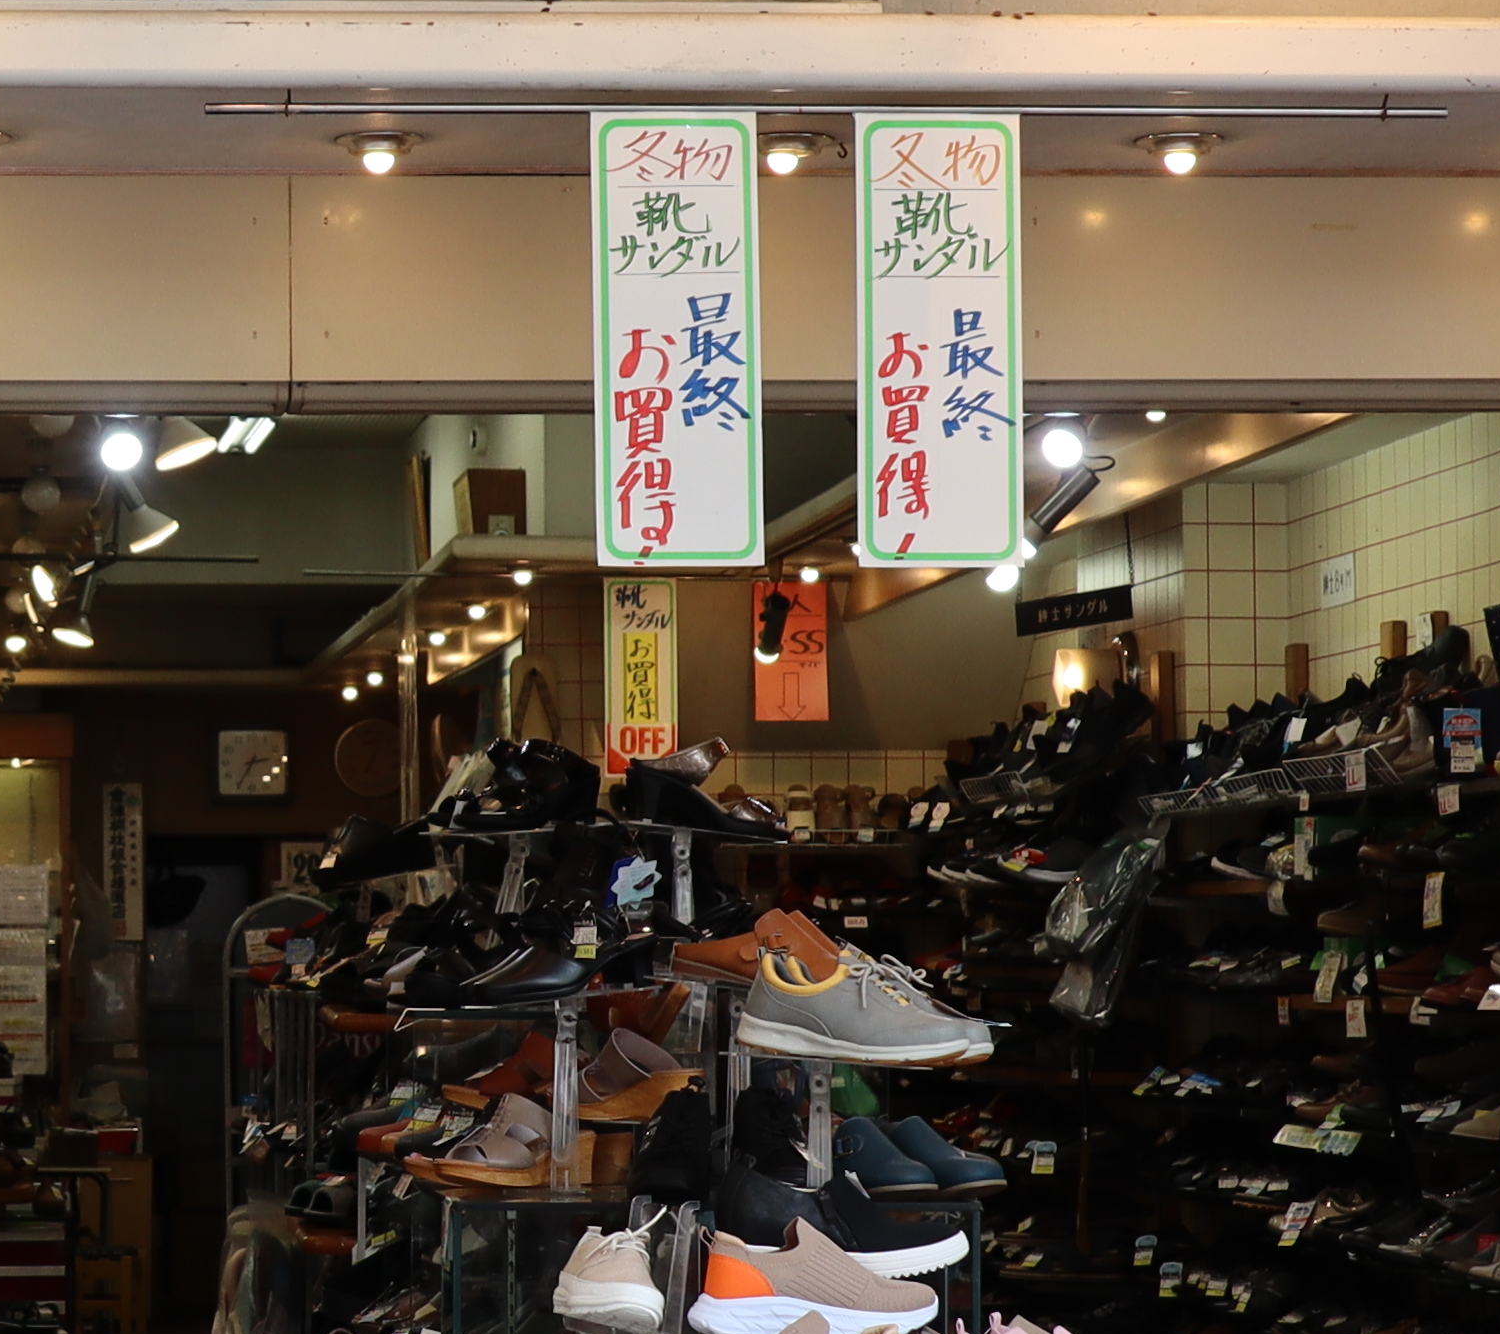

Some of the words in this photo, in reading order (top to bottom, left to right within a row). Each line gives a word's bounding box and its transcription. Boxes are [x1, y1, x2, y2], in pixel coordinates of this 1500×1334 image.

[602, 131, 733, 182] 冬物
[870, 132, 1001, 191] 冬物
[632, 192, 712, 237] 靴
[891, 191, 978, 240] 靴
[610, 235, 740, 278] サンダル
[873, 233, 1011, 280] サンダル
[680, 293, 751, 431] 最終
[940, 309, 1016, 441] 最終
[623, 608, 672, 630] サンダル
[626, 638, 657, 722] お買得
[619, 725, 666, 755] OFF
